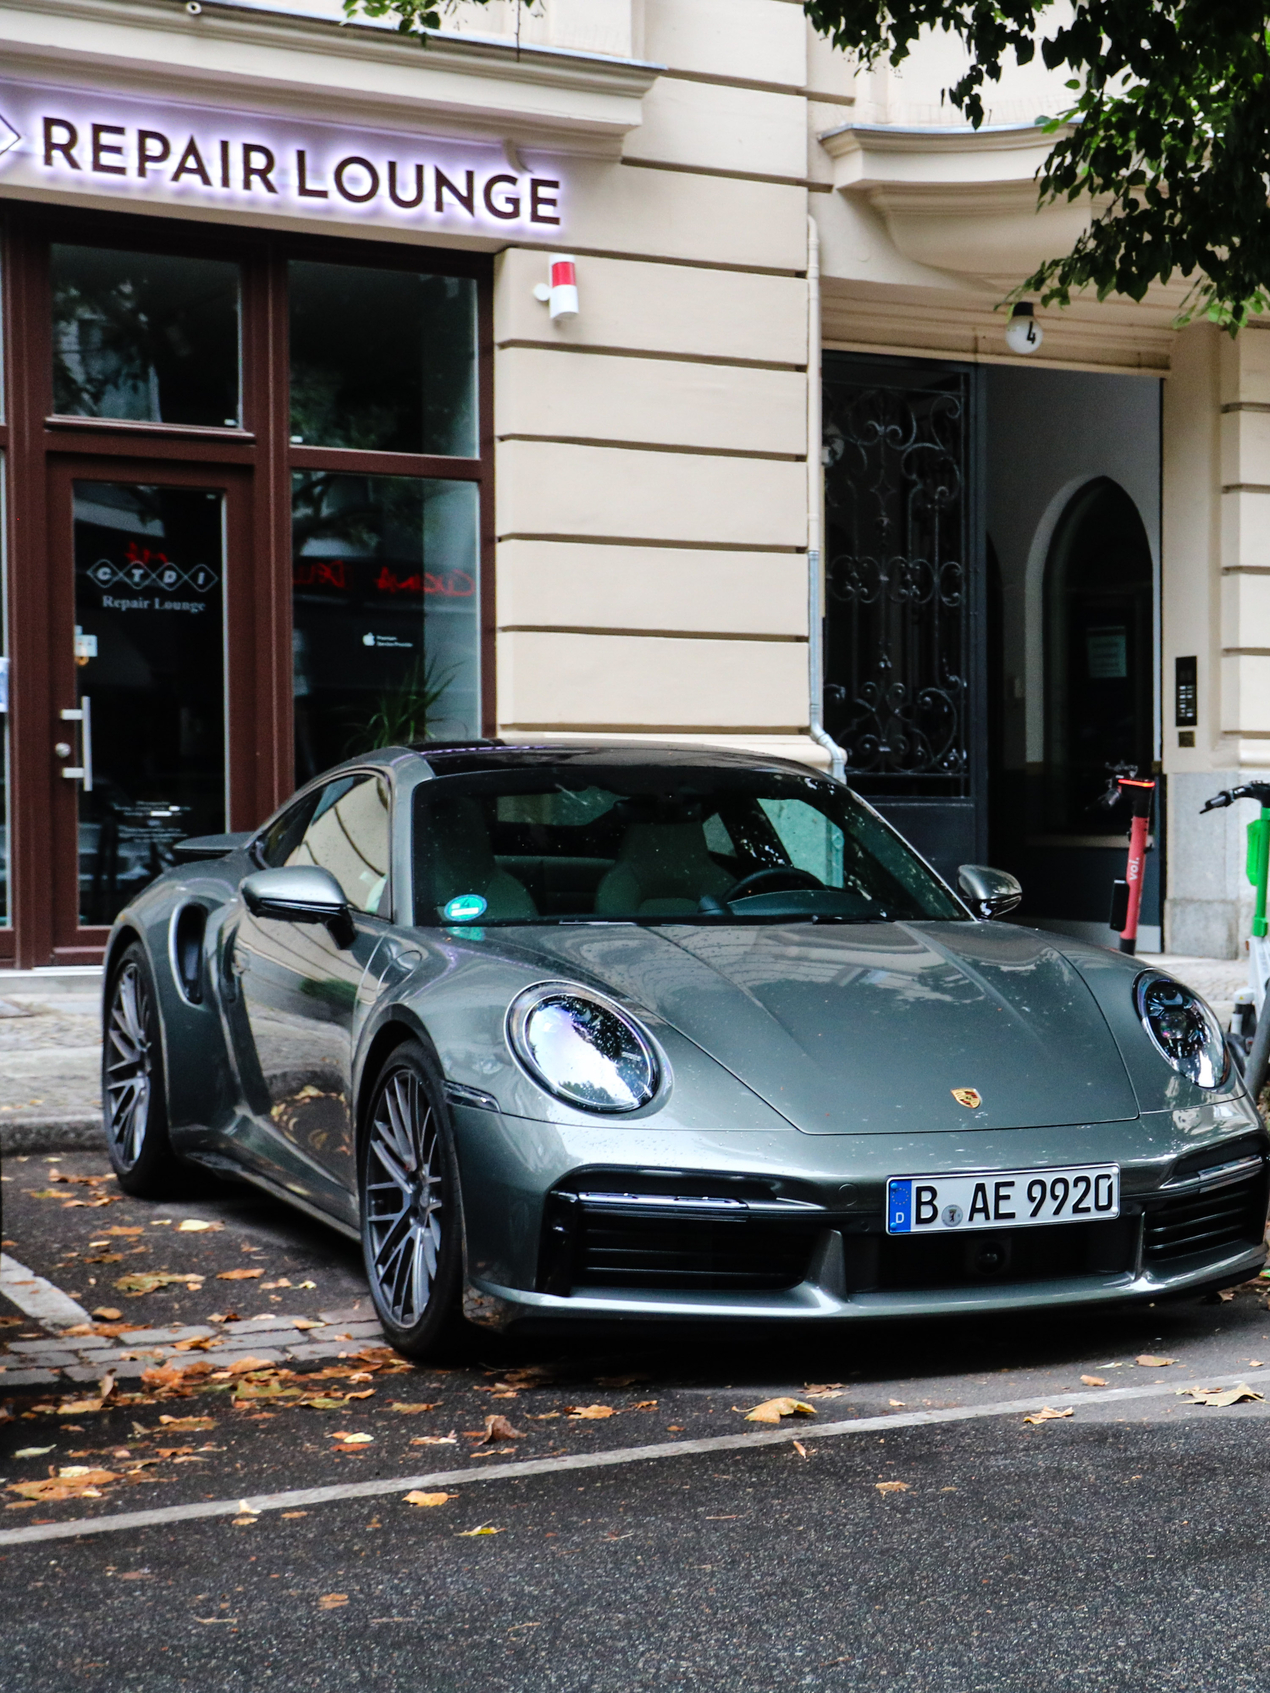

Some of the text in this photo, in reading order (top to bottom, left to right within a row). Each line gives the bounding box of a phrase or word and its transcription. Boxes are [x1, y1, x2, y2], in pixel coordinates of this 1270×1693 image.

[43, 116, 561, 226] REPAIR LOUNGE
[1026, 321, 1036, 344] 4
[97, 567, 205, 585] CTDI
[102, 595, 206, 614] Repair Lounge
[915, 1173, 1113, 1225] B AE 9920
[895, 1213, 905, 1224] D
